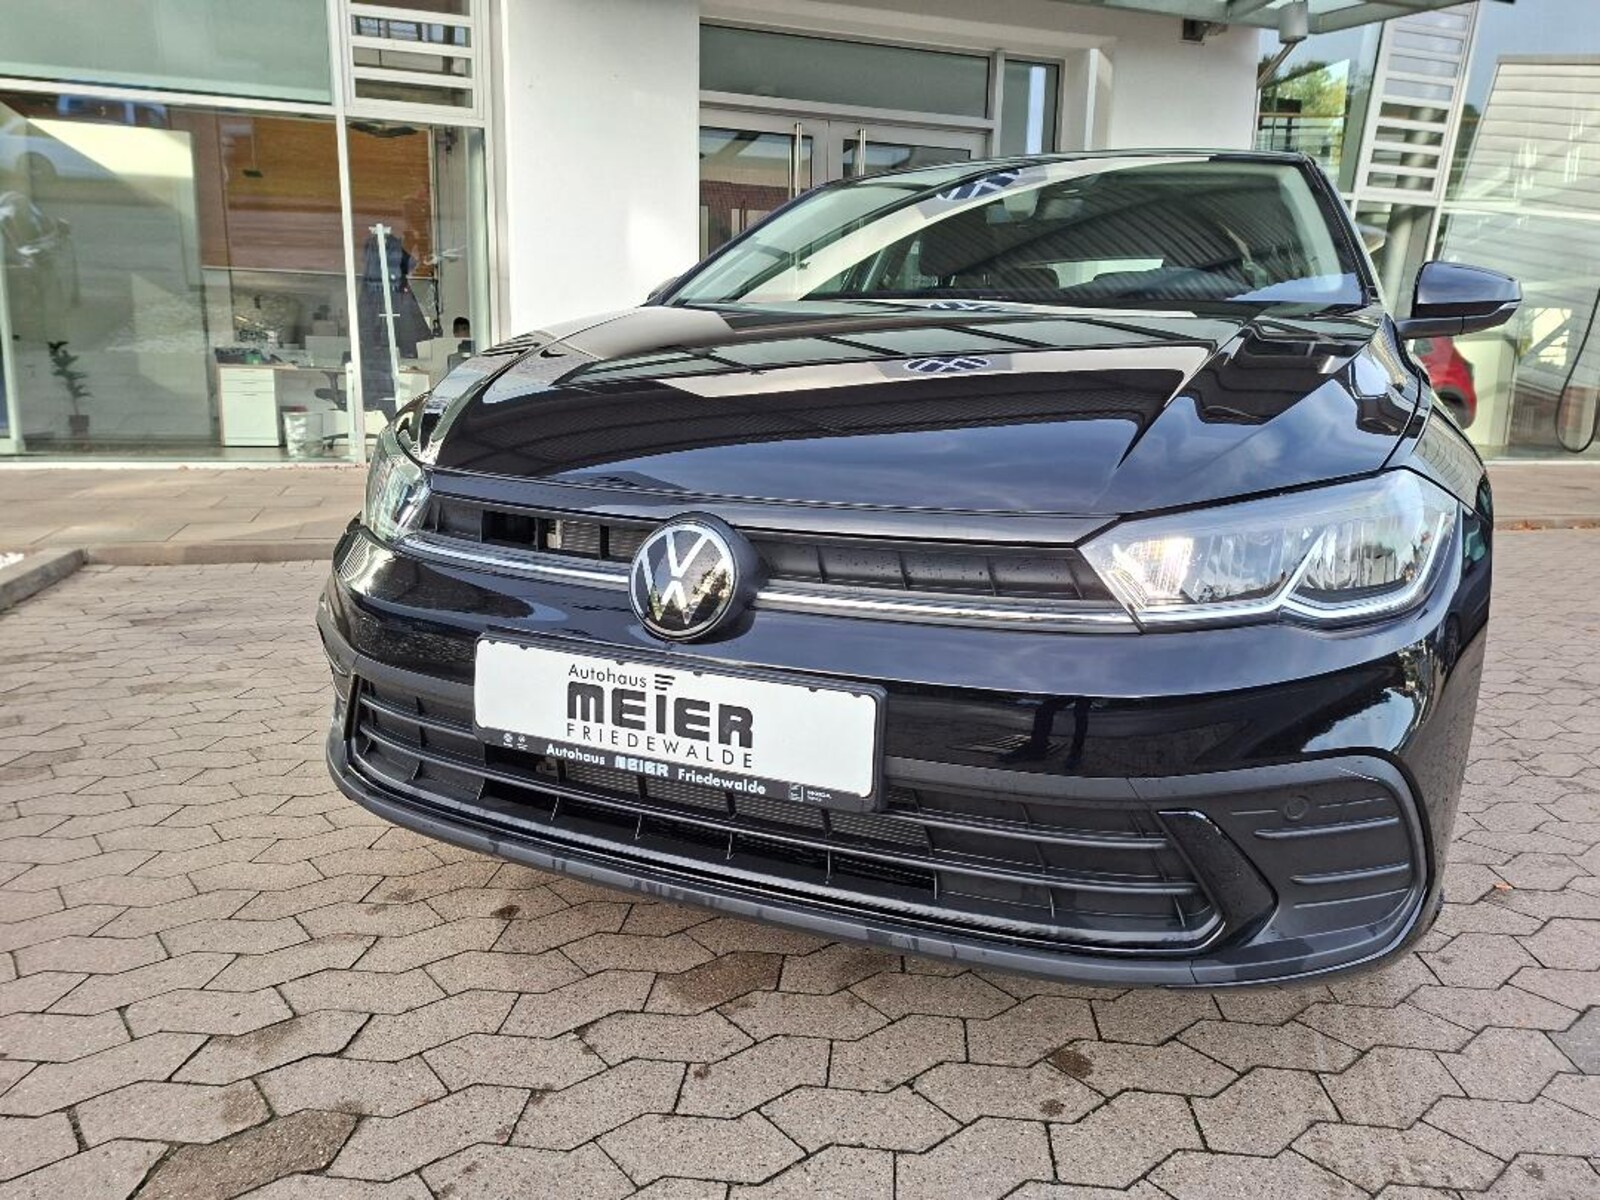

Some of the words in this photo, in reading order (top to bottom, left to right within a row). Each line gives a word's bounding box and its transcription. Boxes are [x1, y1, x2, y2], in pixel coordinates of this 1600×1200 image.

[568, 664, 647, 688] Autohaus
[567, 675, 754, 749] MEIER
[546, 743, 606, 765] Autohaus
[614, 755, 670, 777] MEIER
[678, 768, 767, 795] Friedewalde
[567, 723, 753, 768] FRIEDEWALDE
